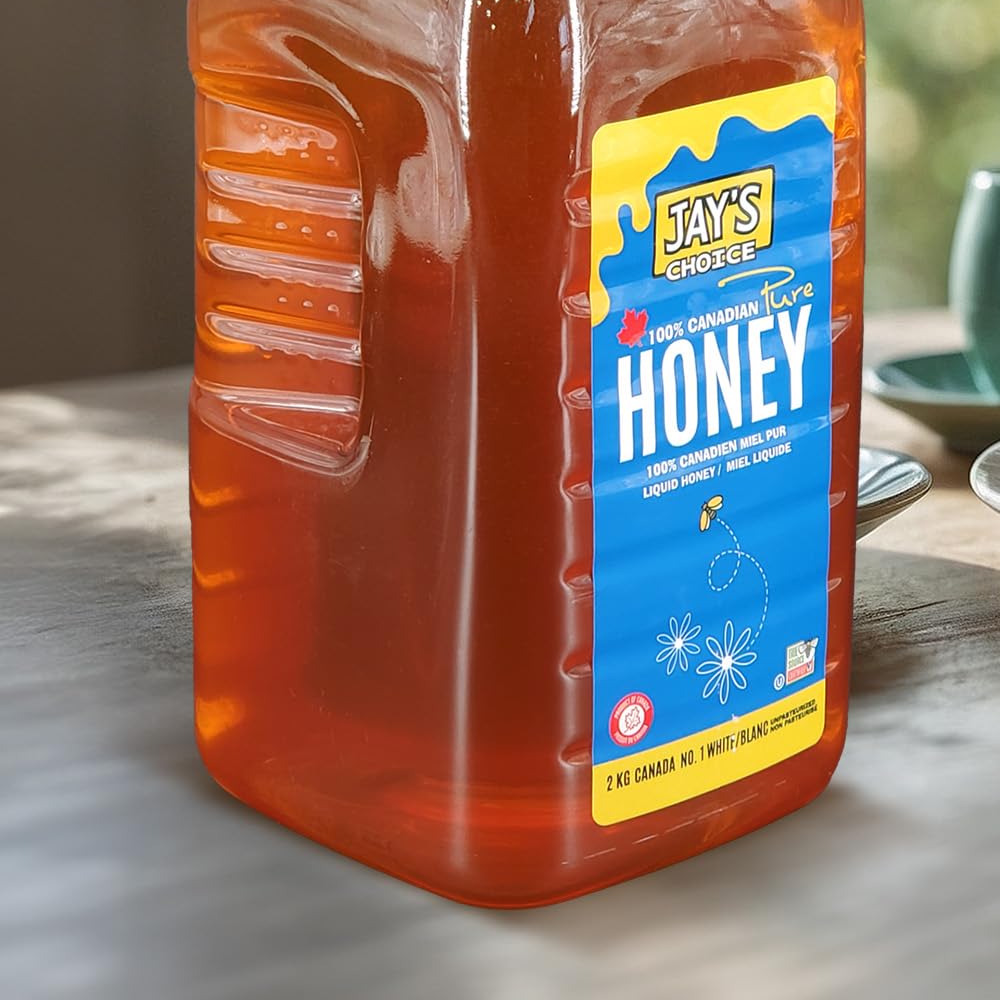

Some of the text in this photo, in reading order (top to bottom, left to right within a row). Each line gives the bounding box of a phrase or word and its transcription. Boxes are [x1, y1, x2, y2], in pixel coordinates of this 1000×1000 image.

[664, 182, 762, 254] JAY'S
[664, 240, 757, 281] CHOICE
[717, 266, 814, 316] Pure
[648, 300, 759, 345] 100% CANADIAN
[617, 303, 813, 464] HONEY
[643, 478, 679, 499] LIQUID
[681, 466, 716, 488] HONEY
[726, 456, 751, 473] MIEL
[752, 442, 792, 465] LIQUIDE
[646, 425, 787, 478] 100% CANADIEN MIEL PUR
[770, 722, 784, 732] NON
[606, 720, 769, 792] 2 KG CANADA NO. 1 WHITE/BLANC
